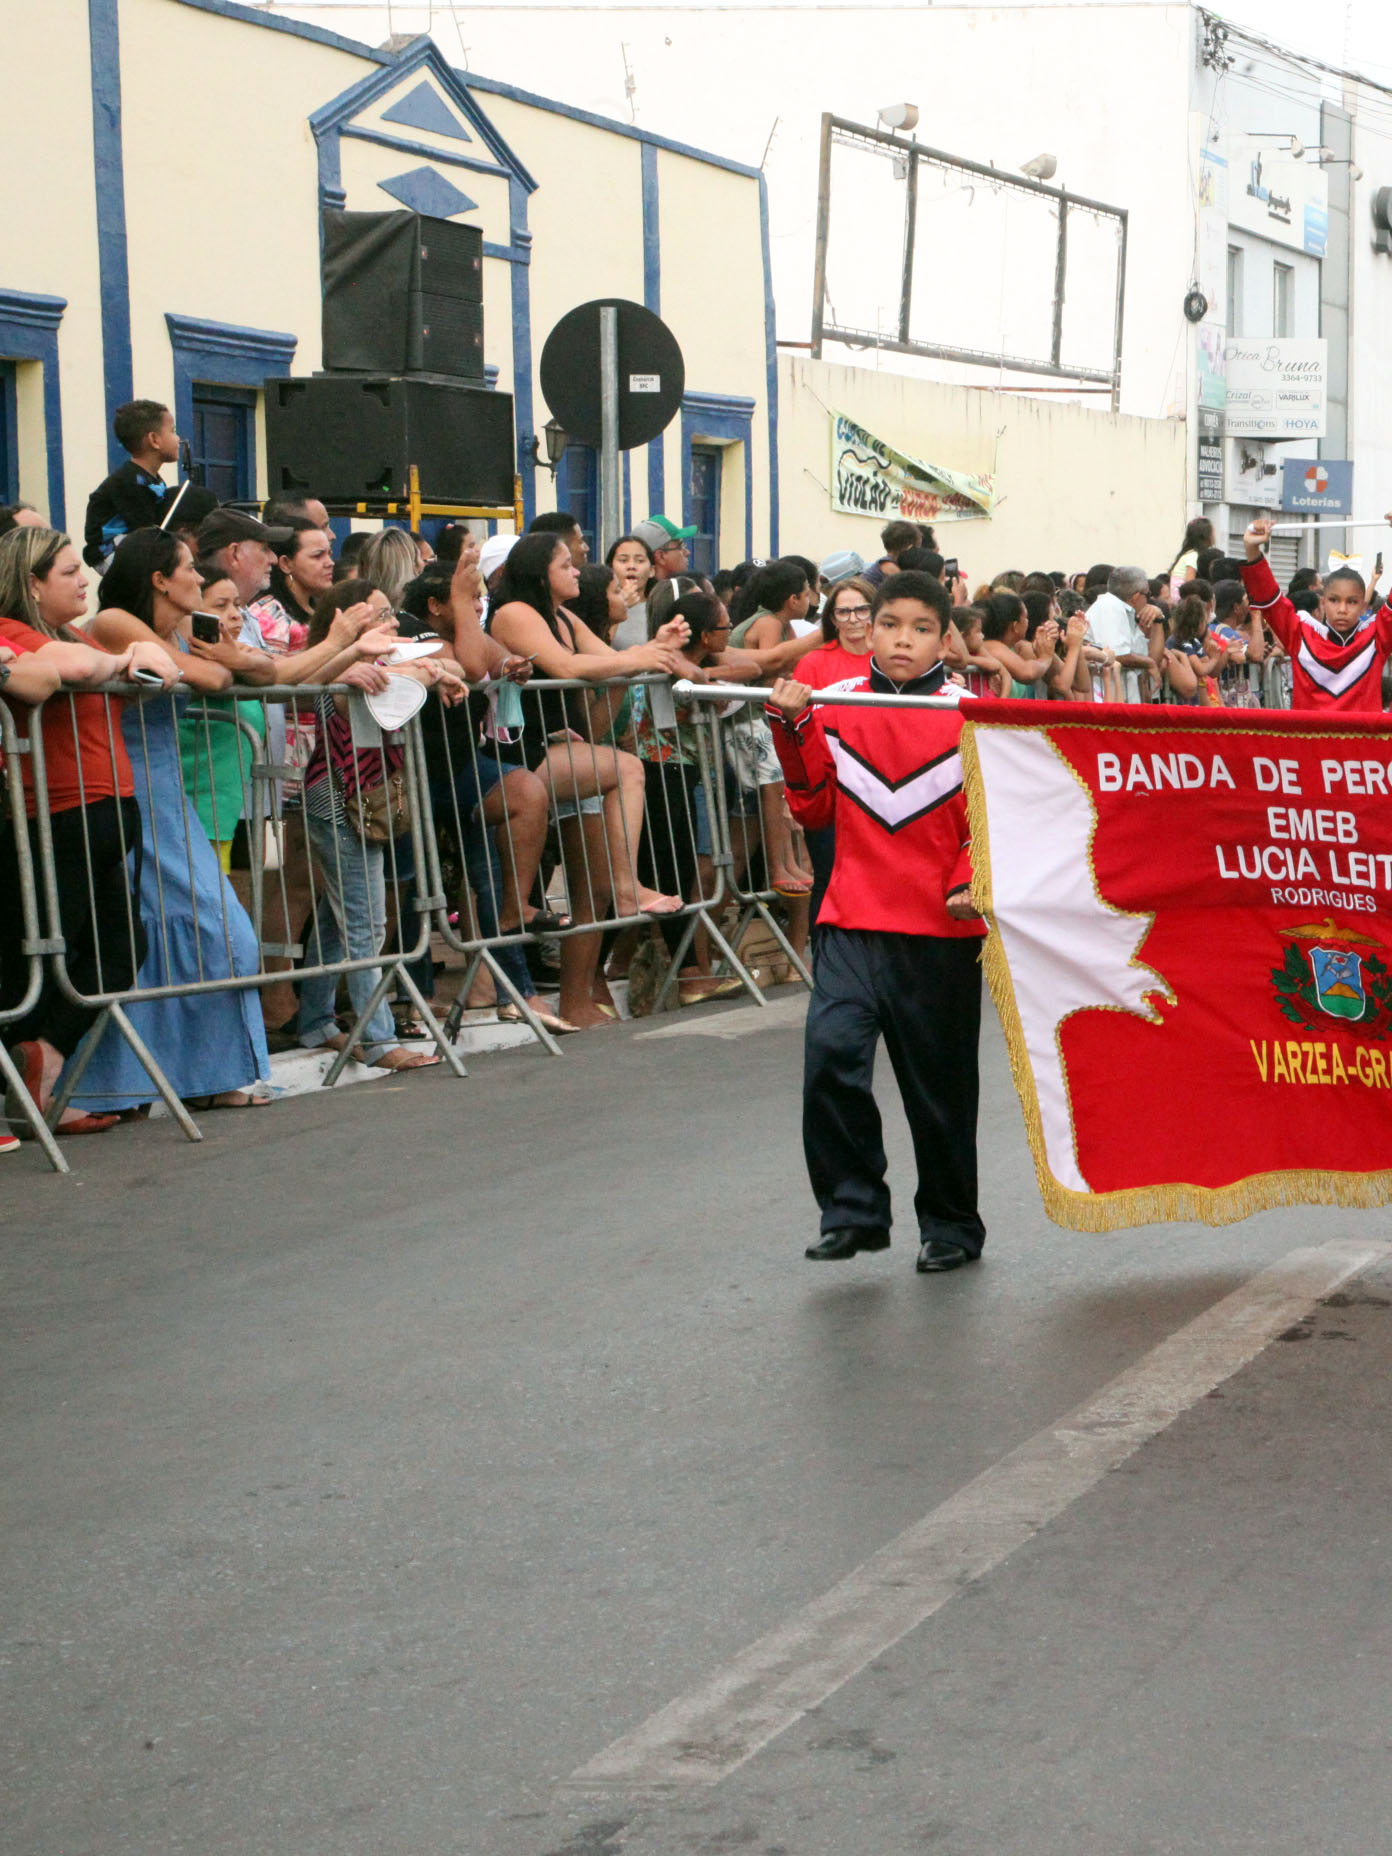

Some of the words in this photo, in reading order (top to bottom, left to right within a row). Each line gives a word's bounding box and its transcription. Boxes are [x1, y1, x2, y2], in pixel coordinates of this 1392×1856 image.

[1260, 345, 1321, 373] Bruna
[1226, 390, 1251, 399] Crizal
[1227, 418, 1276, 430] Transitions
[1285, 419, 1318, 429] HOYA
[1292, 496, 1342, 508] Loterias
[1097, 752, 1237, 793] BANDA
[1253, 756, 1302, 796] DE
[1267, 806, 1359, 844] EMEB
[1215, 844, 1321, 882] LUCIA
[1271, 887, 1377, 913] RODRIGUES
